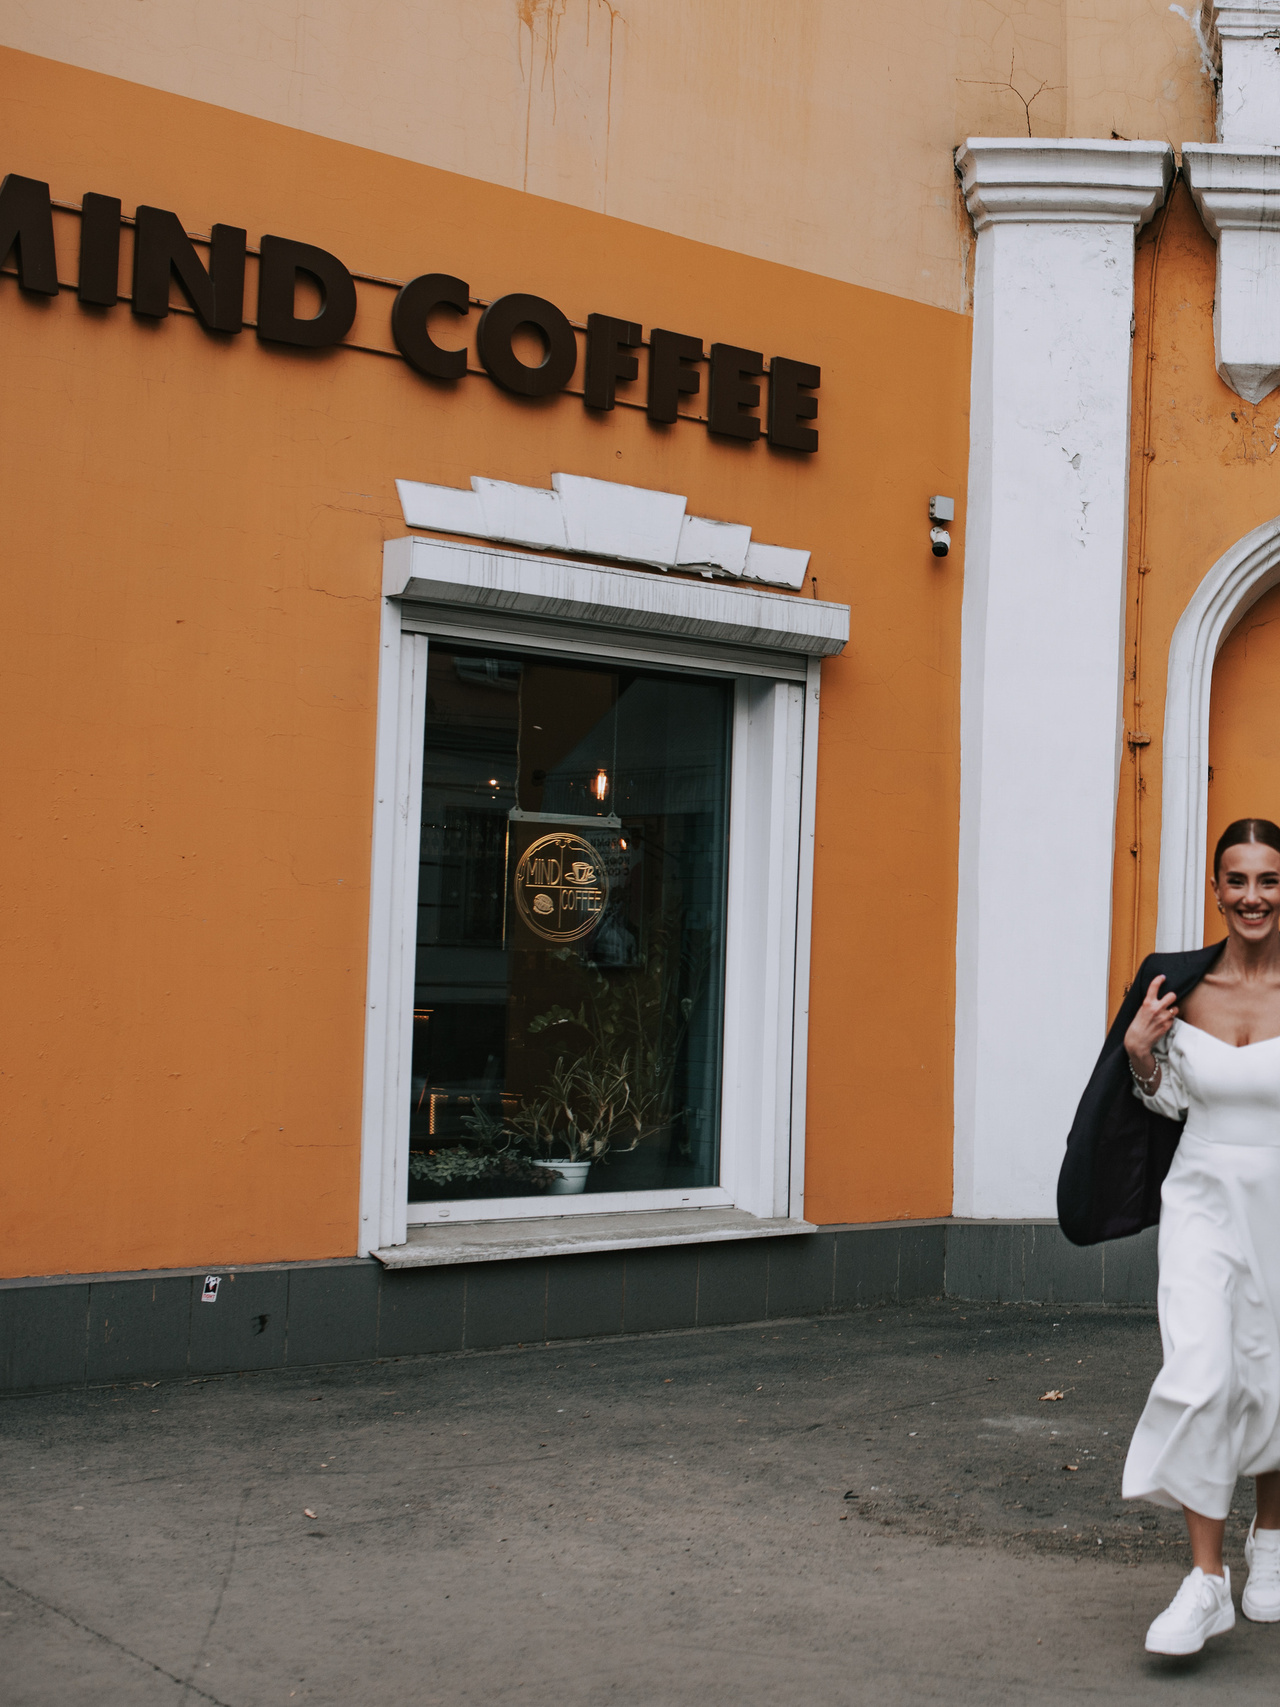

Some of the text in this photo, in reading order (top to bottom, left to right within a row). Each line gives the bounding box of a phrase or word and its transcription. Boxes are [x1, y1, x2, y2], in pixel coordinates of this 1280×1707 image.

[391, 273, 821, 453] COFFEE
[526, 858, 561, 886] MIND
[561, 889, 602, 911] COFFEE
